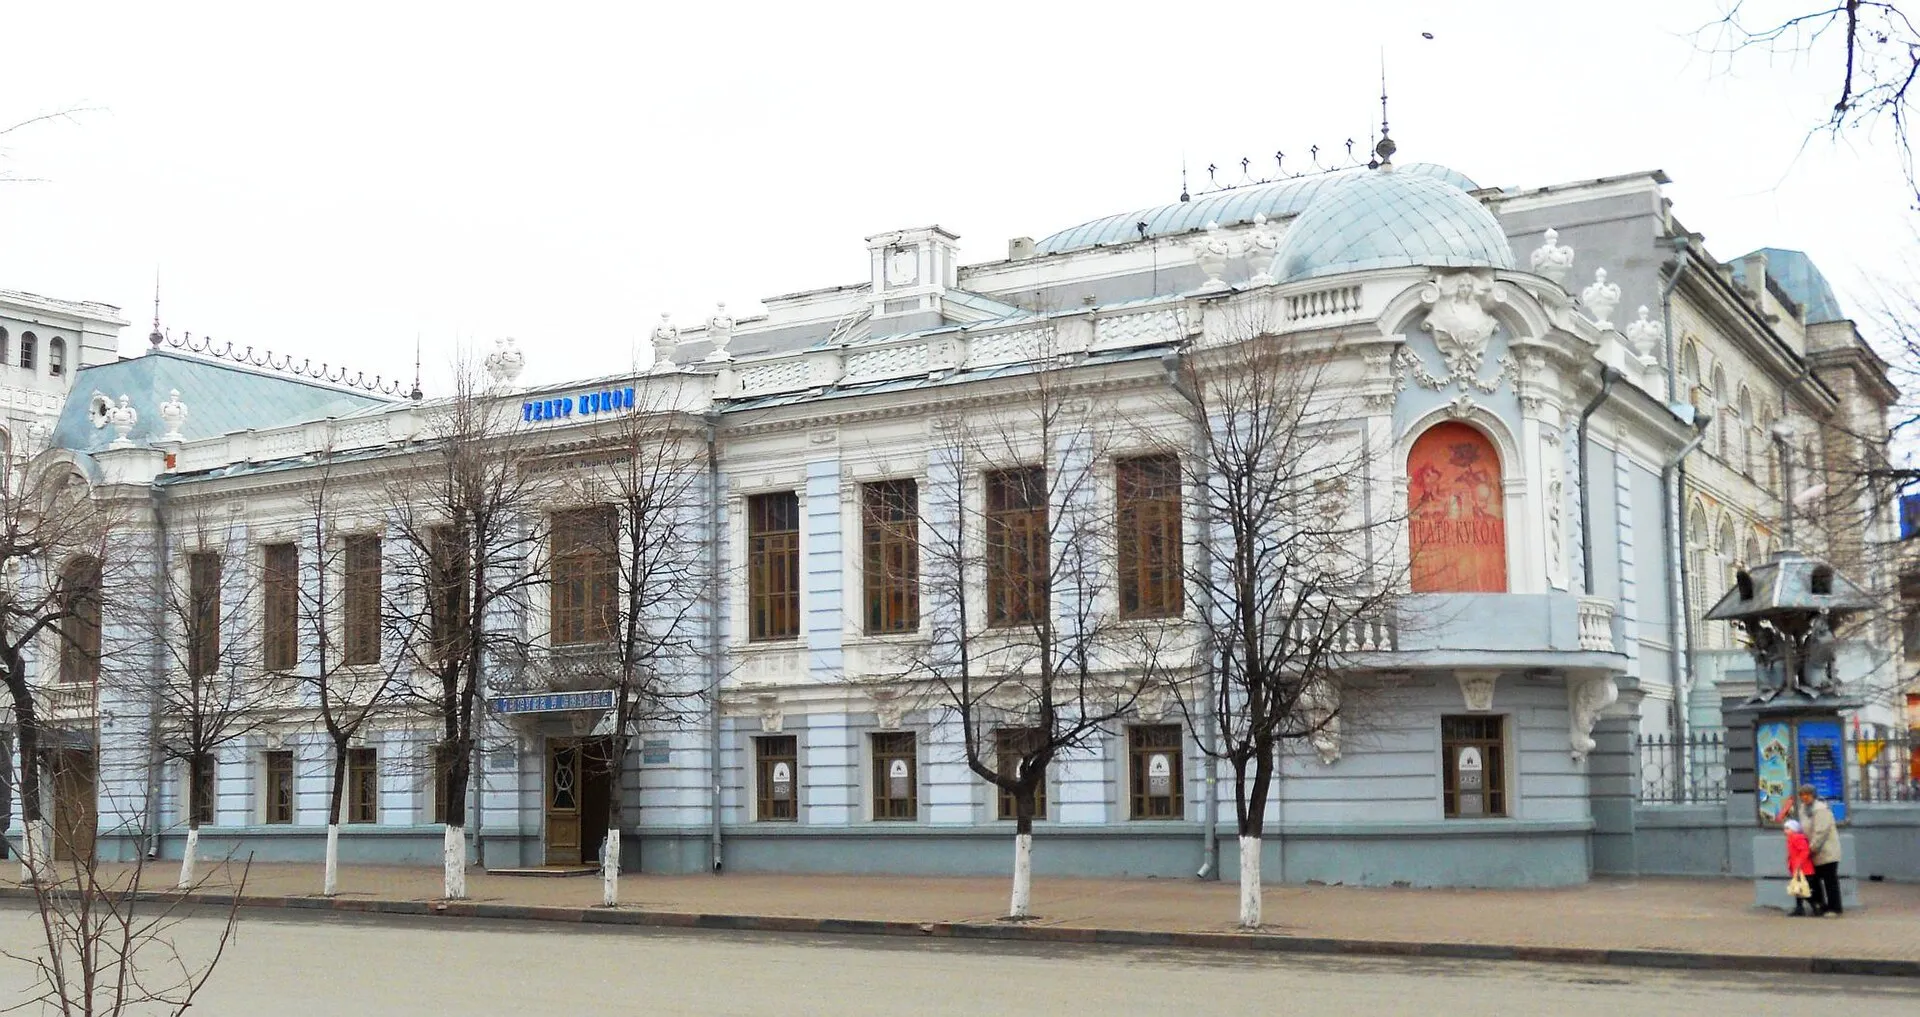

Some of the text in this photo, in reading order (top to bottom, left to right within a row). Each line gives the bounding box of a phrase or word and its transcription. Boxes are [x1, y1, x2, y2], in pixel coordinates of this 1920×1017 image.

[523, 387, 633, 421] ТЕАТР КУКОЛ
[1412, 520, 1498, 544] ТЕАТР КУКОЛ
